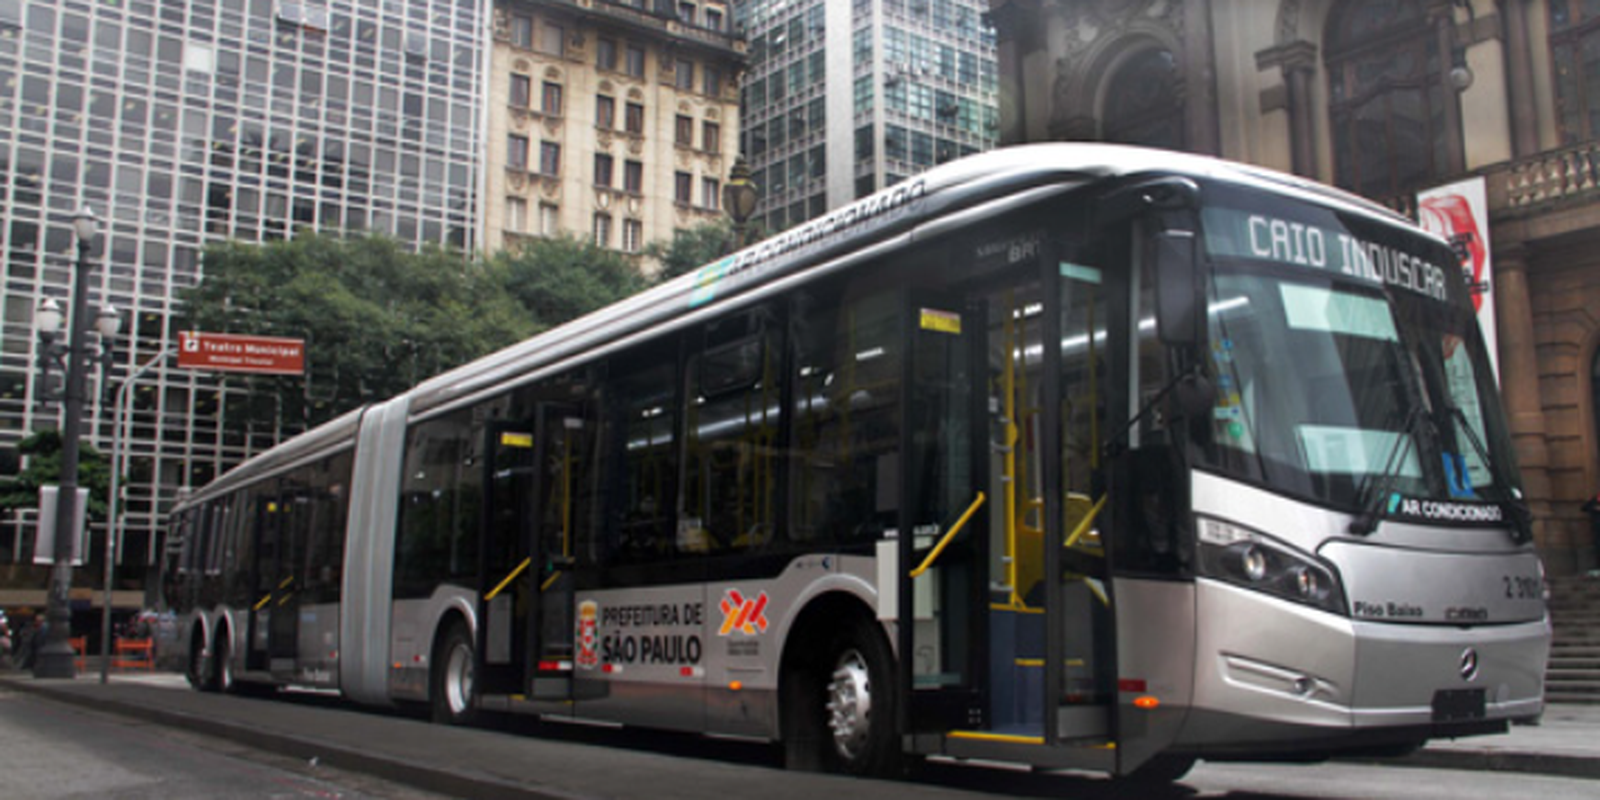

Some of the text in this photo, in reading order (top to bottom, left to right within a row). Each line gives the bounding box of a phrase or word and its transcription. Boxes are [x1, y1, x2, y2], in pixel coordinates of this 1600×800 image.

[1249, 215, 1327, 268] CAIO
[1338, 234, 1447, 300] INDUSCAR
[203, 341, 300, 357] Teatro Municipal
[1402, 499, 1421, 515] AR
[602, 603, 703, 627] PREFEITURA DE
[1354, 601, 1424, 617] Piso Baixo
[602, 630, 638, 663] SÃO
[641, 634, 702, 664] PAULO
